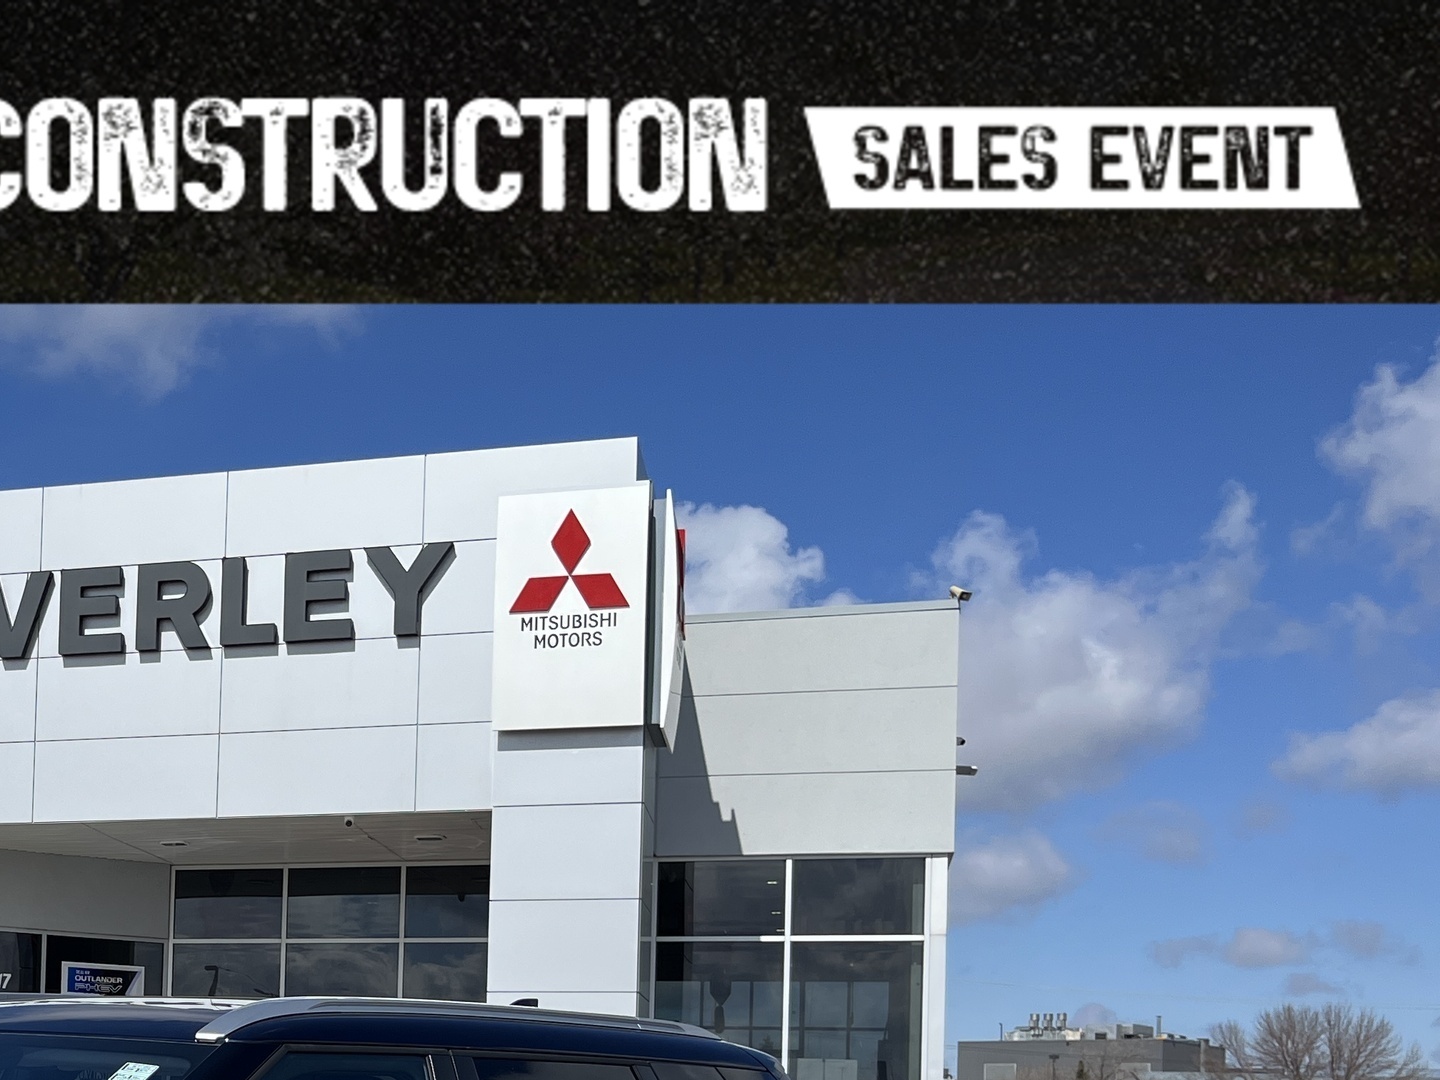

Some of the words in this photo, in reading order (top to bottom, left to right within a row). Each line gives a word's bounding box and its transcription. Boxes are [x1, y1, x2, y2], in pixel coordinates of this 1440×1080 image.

[520, 612, 617, 632] MITSUBISHI
[533, 631, 603, 649] MOTORS
[74, 975, 123, 984] OUTLANDER
